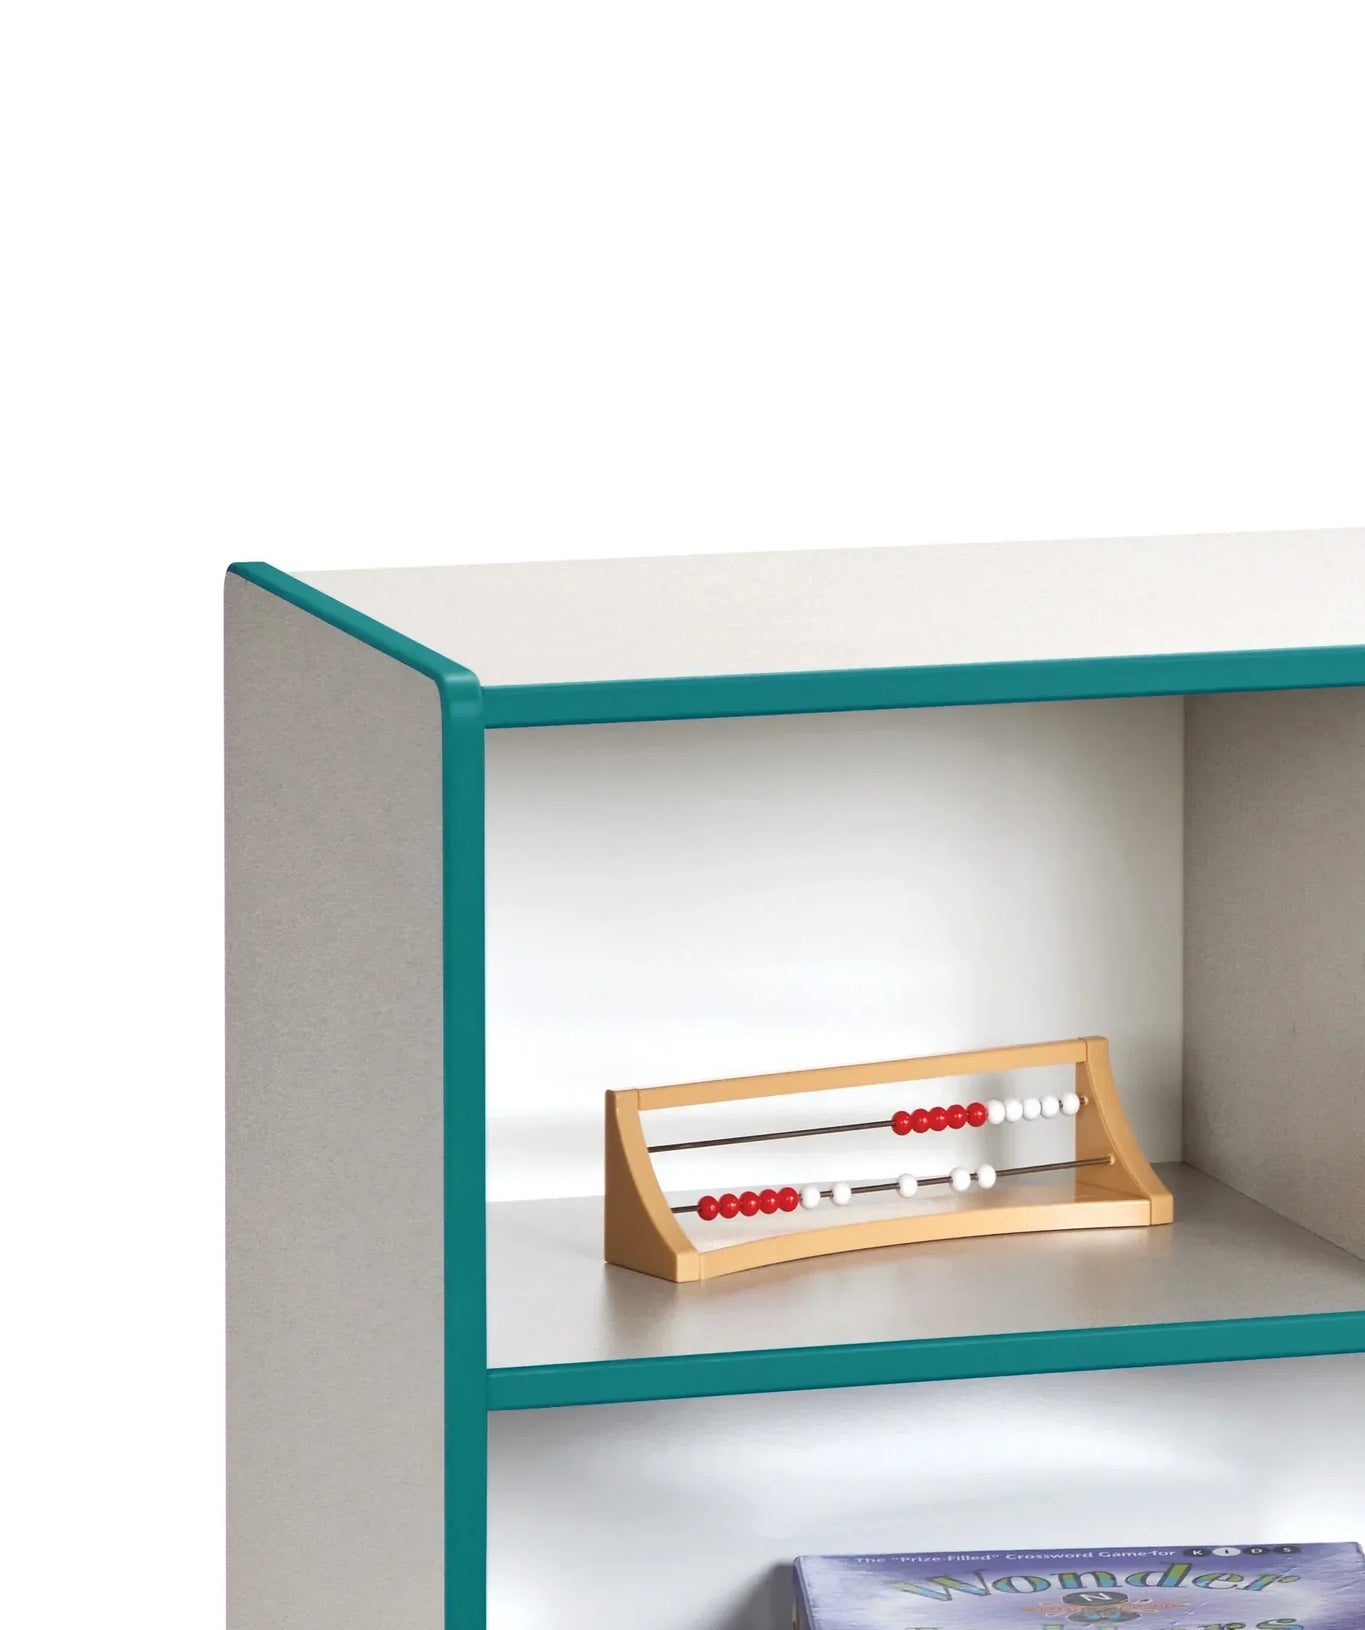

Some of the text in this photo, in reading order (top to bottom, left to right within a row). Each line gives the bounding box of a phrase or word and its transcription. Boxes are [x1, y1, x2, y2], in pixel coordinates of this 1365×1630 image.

[1005, 1551, 1093, 1561] Crossword
[1098, 1550, 1149, 1558] Game
[1151, 1549, 1175, 1557] for
[886, 1563, 1301, 1601] Wonder
